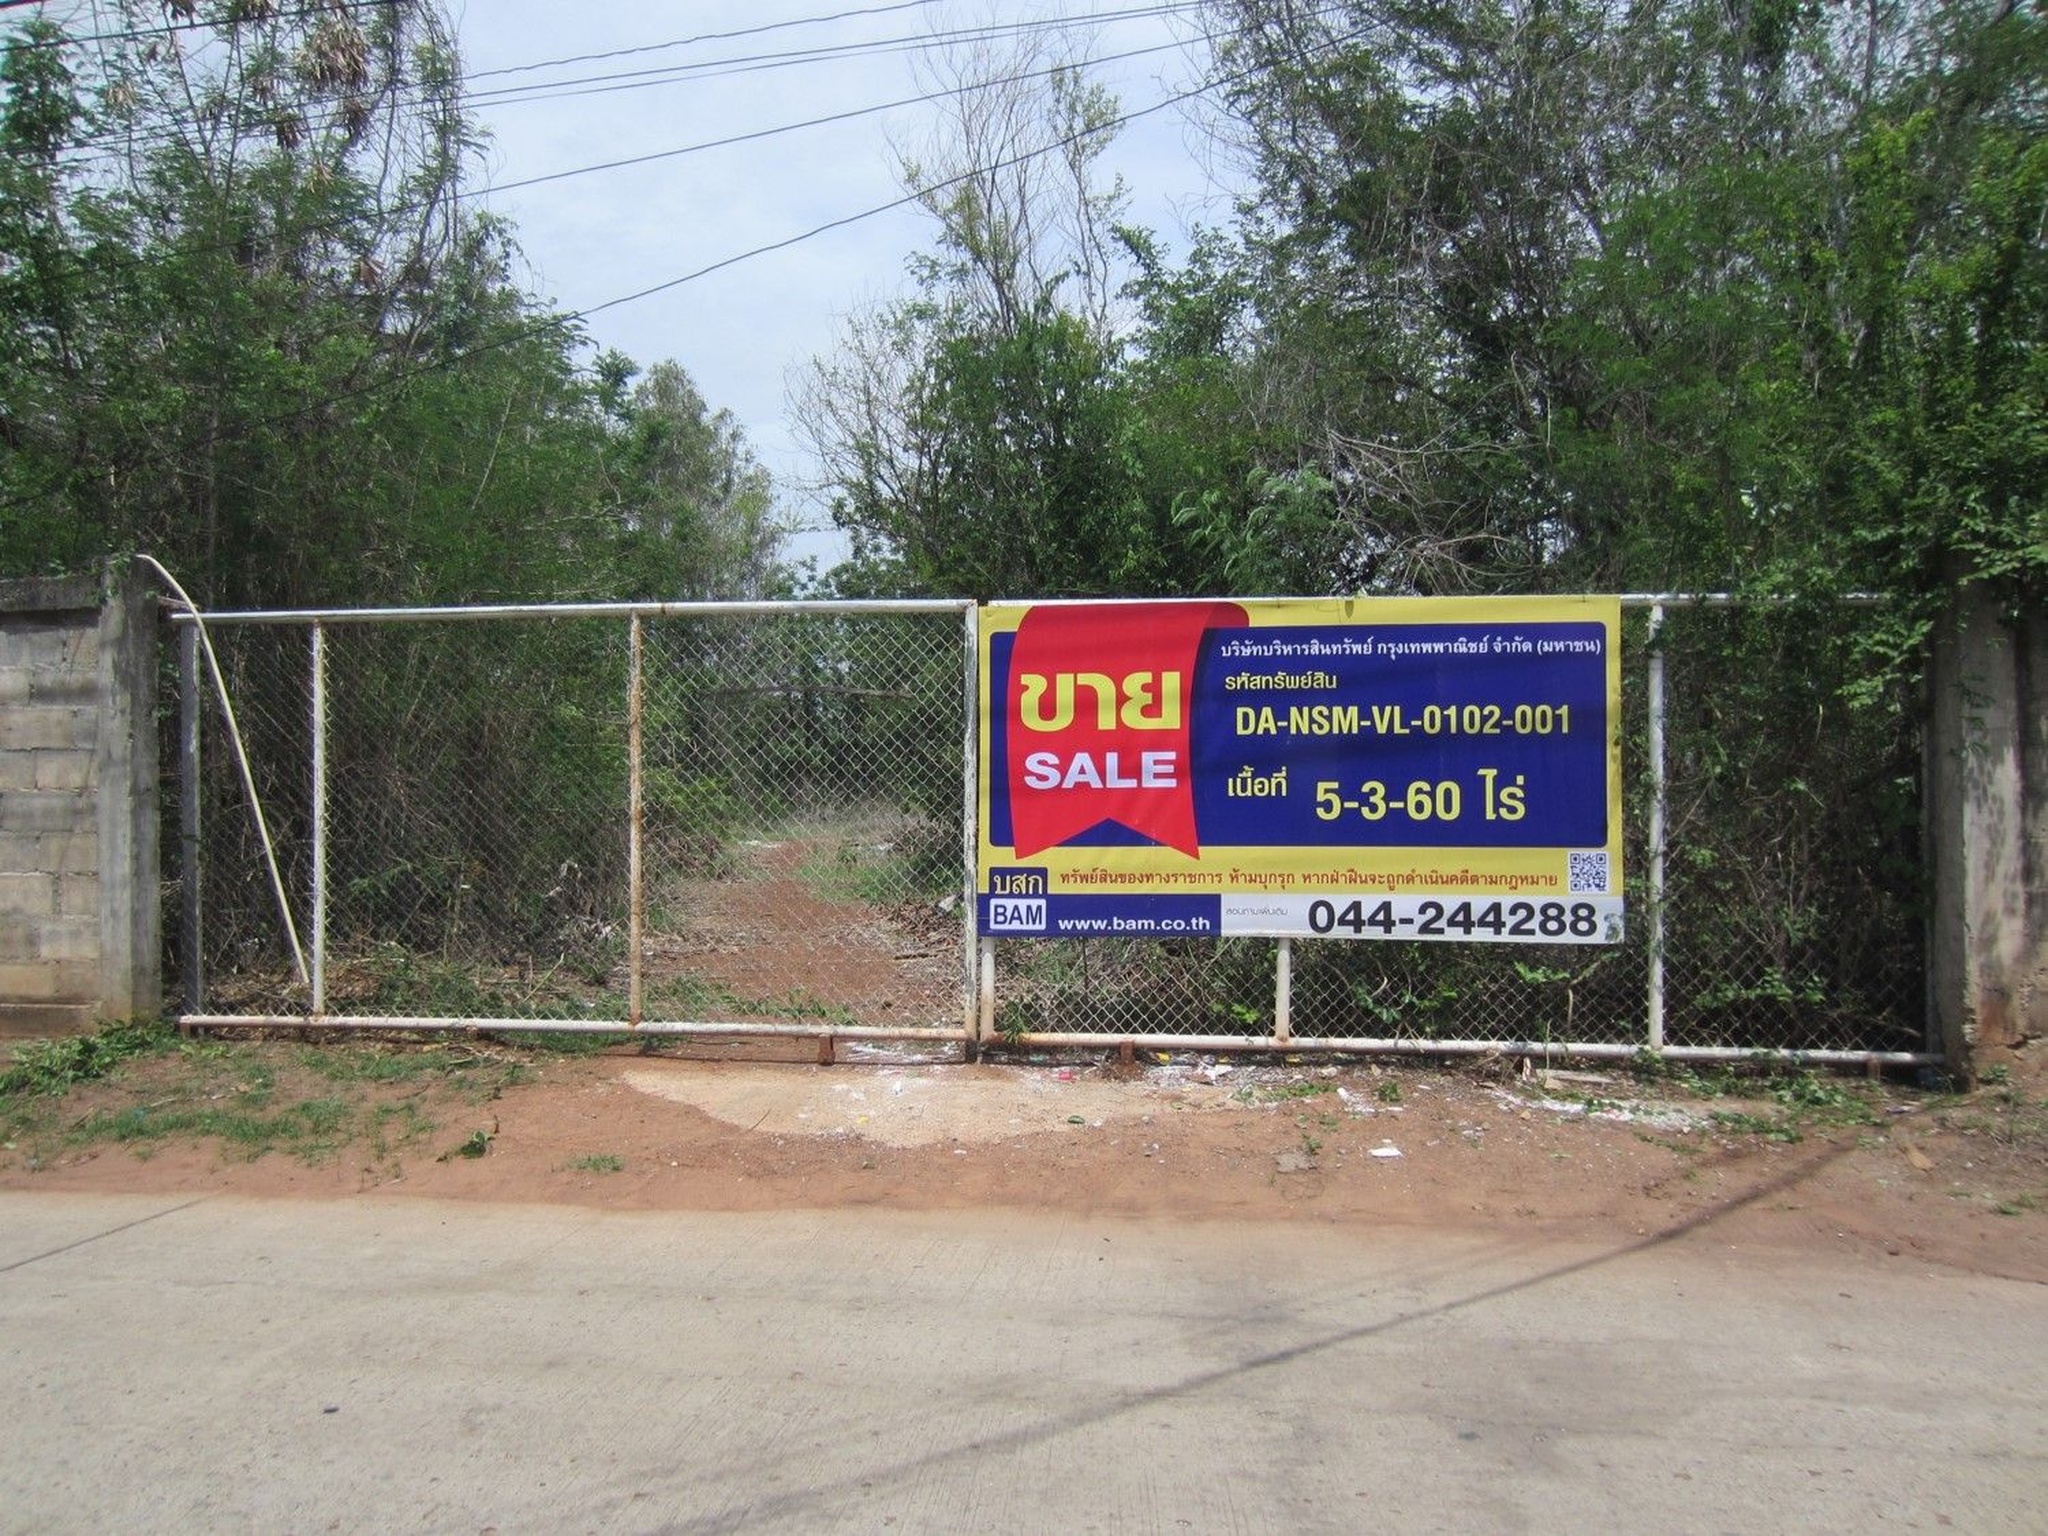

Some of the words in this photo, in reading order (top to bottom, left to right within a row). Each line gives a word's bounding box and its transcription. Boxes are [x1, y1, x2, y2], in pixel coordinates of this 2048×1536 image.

[1221, 636, 1373, 658] บริษัทบริหารสินทรัพย์
[1377, 636, 1488, 660] กรุงเทพพาณิชย์
[1492, 635, 1532, 654] จำกัด
[1537, 638, 1601, 655] (มหาชน)
[1225, 671, 1337, 691] รหัสทรัพย์สิน
[1020, 671, 1181, 732] ขาย
[1236, 704, 1570, 735] DA-NSM-VL-0102-001
[1024, 750, 1178, 789] SALE
[1227, 765, 1288, 797] เนื้อที่
[1316, 780, 1461, 820] 5-3-60
[1477, 768, 1526, 820] ไร่
[993, 872, 1043, 895] บสก
[1060, 867, 1223, 885] ทรัพย์สินของทางราชการ
[1228, 868, 1295, 890] ห้ามบุกรุก
[993, 904, 1043, 926] BAM
[1058, 916, 1211, 931] www.bam.co.th
[1308, 899, 1597, 937] 044-244288
